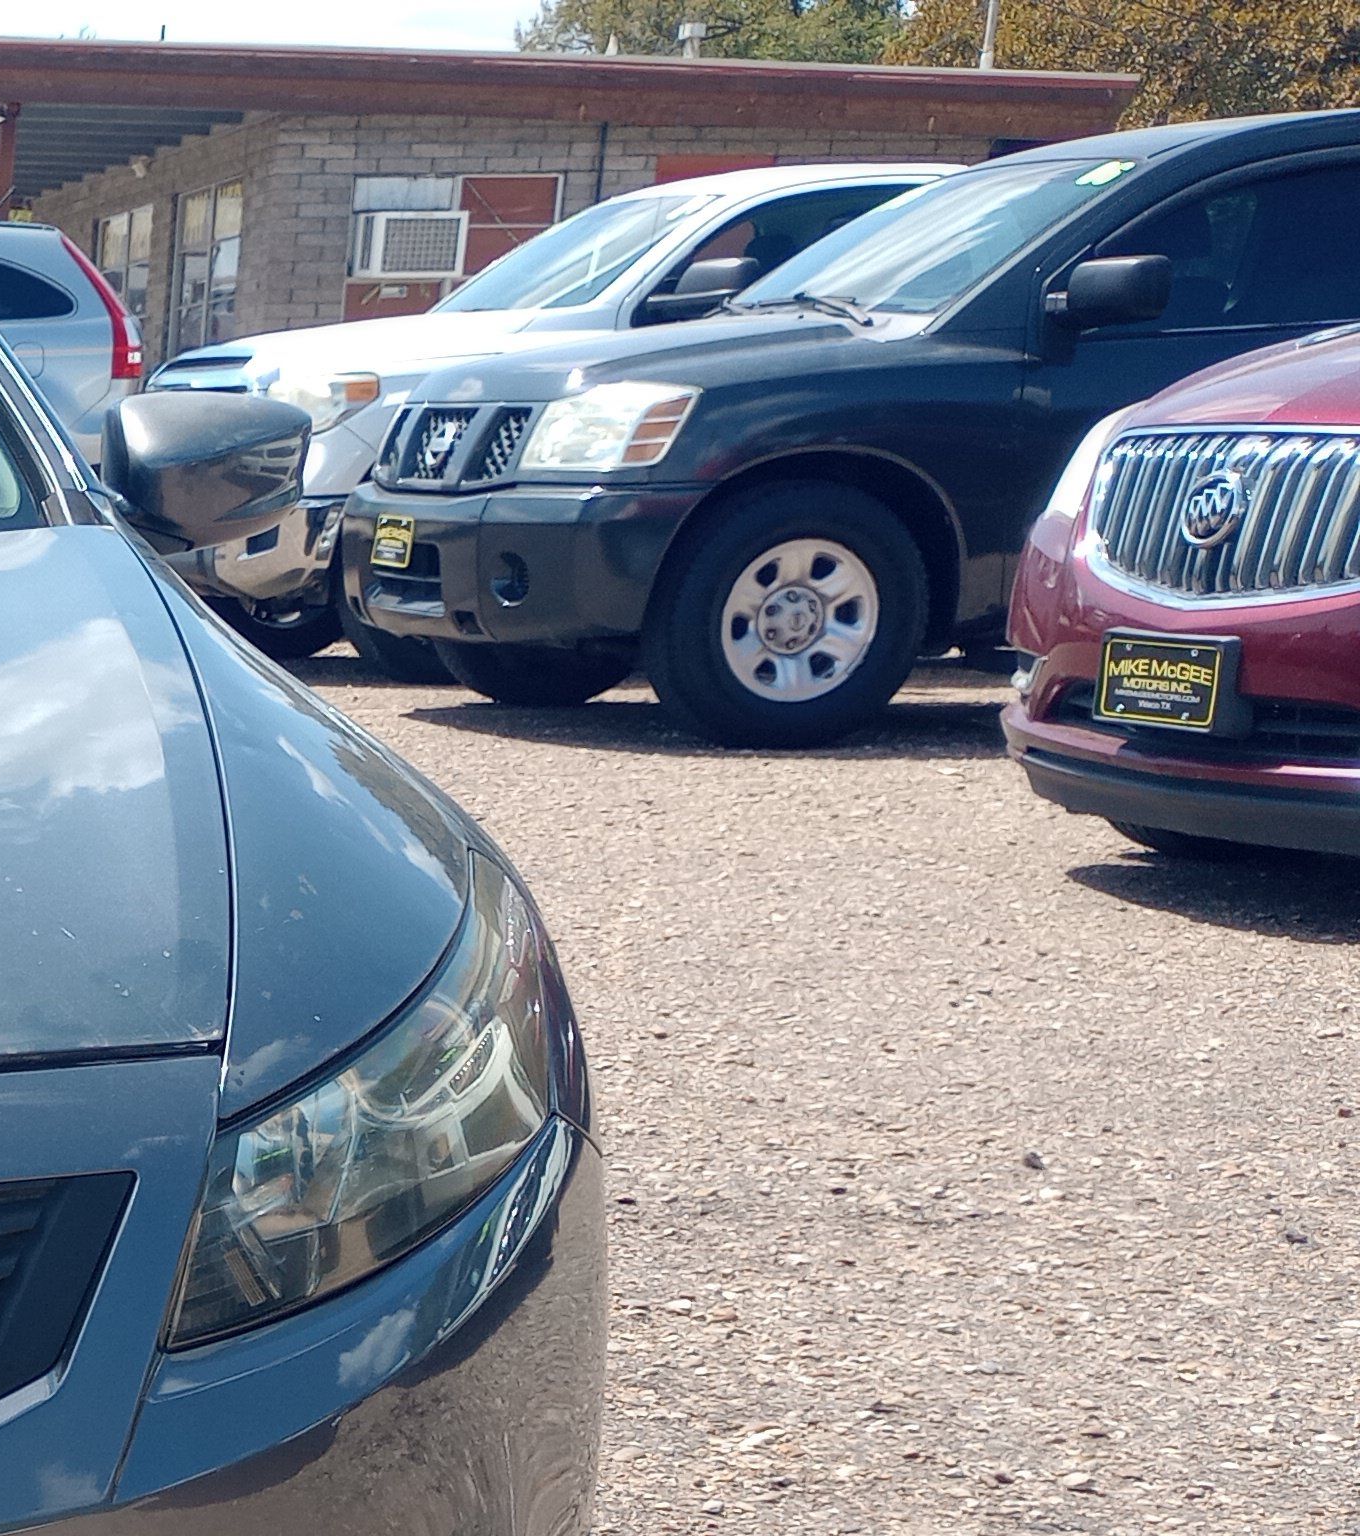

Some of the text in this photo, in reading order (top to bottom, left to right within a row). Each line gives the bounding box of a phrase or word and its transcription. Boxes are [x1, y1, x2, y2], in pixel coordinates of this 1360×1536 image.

[1109, 659, 1150, 677] MIKE
[1122, 677, 1193, 694] MOTORS INC.
[1114, 688, 1200, 704] MGEEMOTORS.COM
